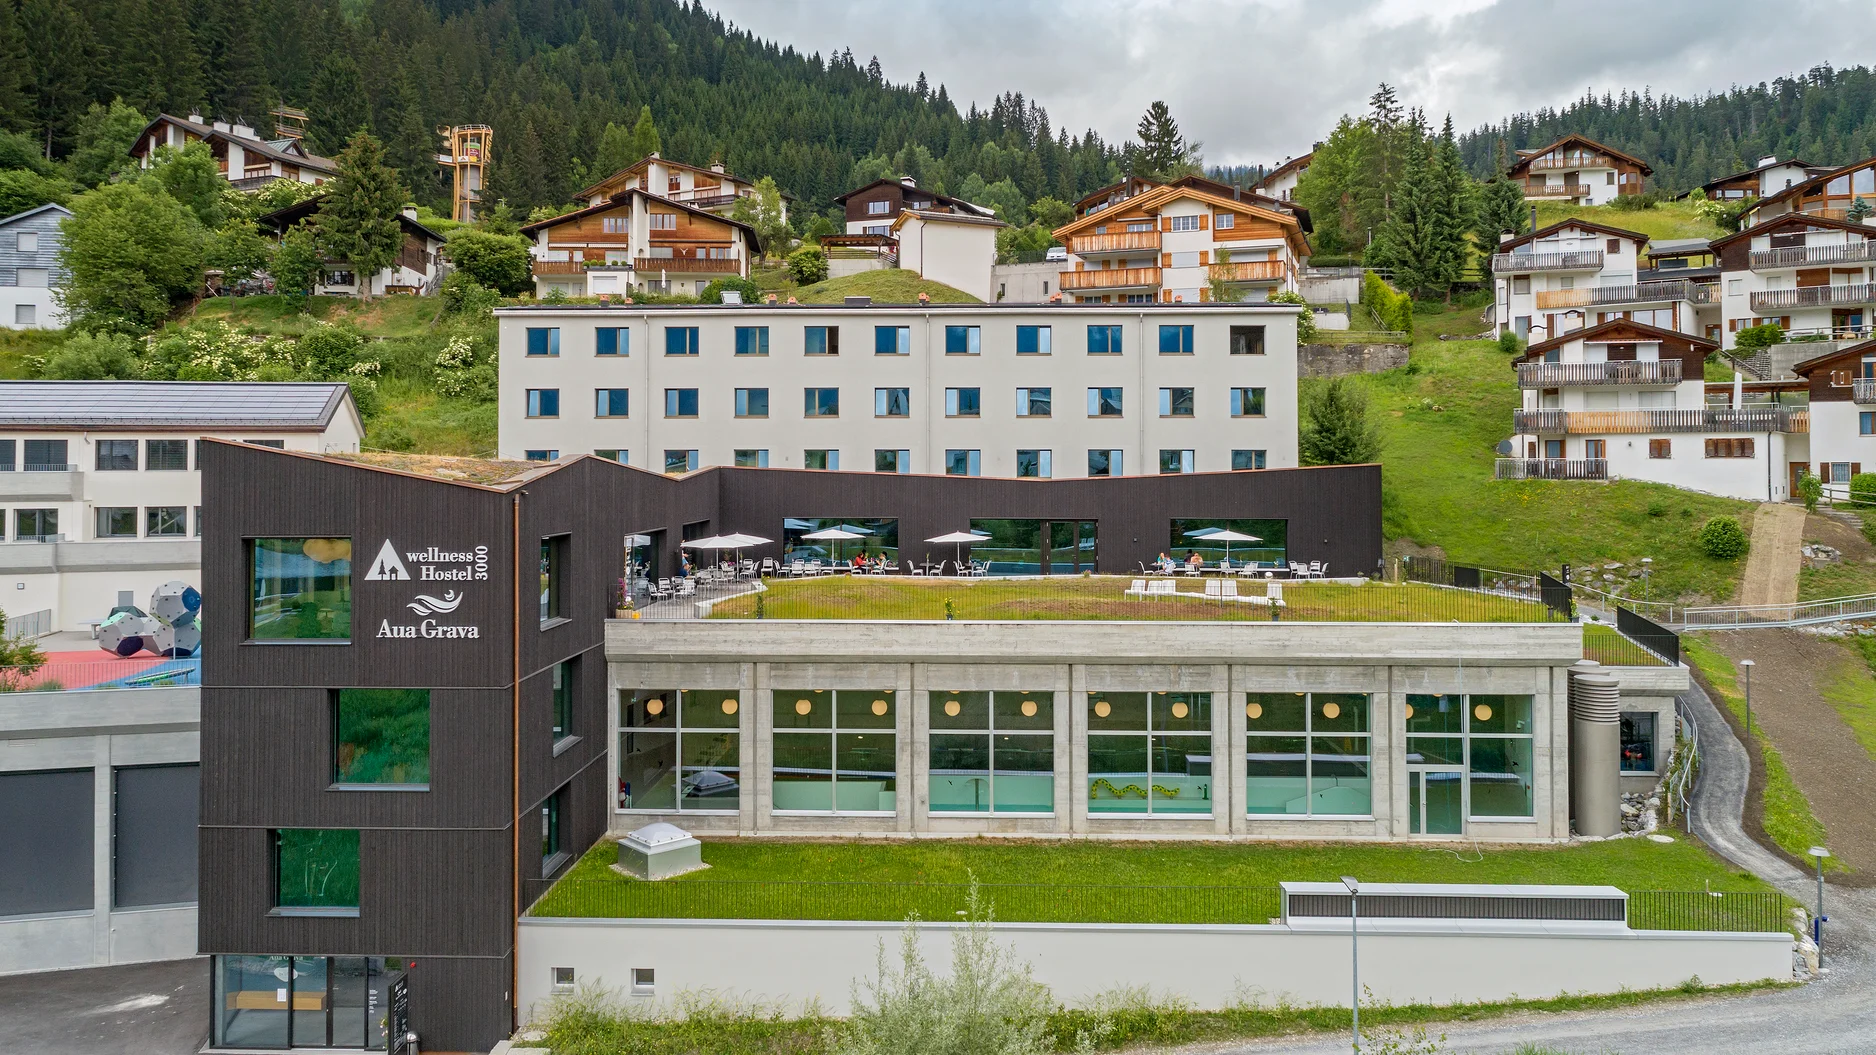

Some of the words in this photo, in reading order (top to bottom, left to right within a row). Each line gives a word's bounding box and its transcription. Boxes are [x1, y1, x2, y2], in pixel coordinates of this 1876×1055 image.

[406, 547, 474, 562] wellness
[475, 545, 488, 580] 3000
[420, 565, 473, 581] Hostel
[376, 618, 417, 638] Aua
[420, 618, 480, 639] Grava
